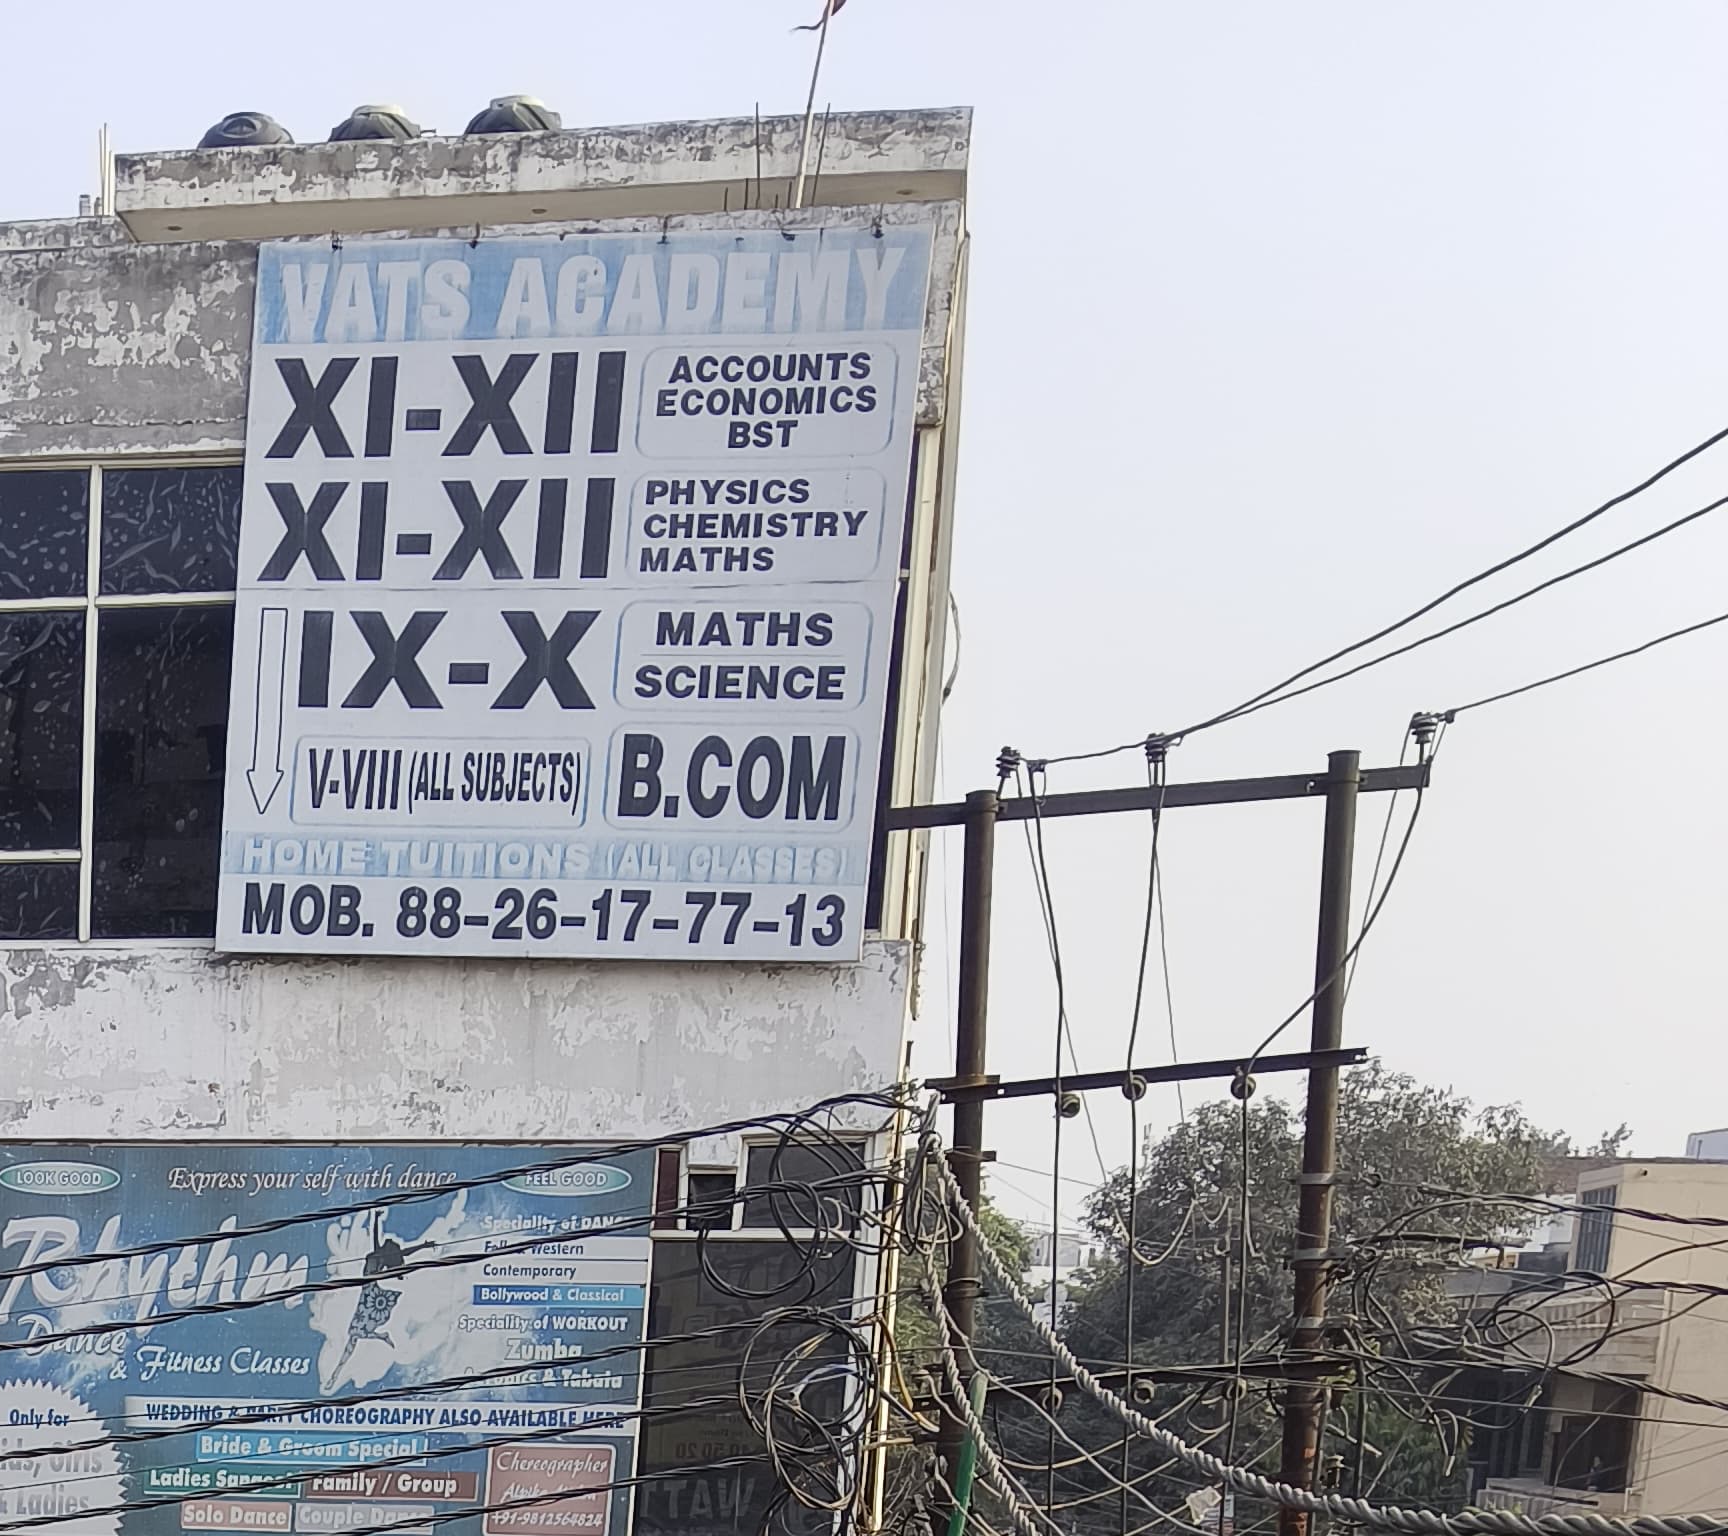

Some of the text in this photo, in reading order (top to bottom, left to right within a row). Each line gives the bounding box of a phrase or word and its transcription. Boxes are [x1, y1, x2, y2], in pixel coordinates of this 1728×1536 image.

[281, 245, 908, 341] VATS ACADEMY
[669, 353, 872, 384] ACCOUNTS
[264, 351, 627, 459] XI-XII
[655, 385, 878, 418] ECONOMICS
[727, 420, 798, 450] BST
[644, 479, 811, 506] PHYSICS
[256, 477, 617, 582] XI-XII
[642, 511, 869, 540] CHEMISTRY
[639, 547, 775, 573] MATHS
[655, 612, 834, 647] MATHS
[297, 610, 603, 710] IX-X
[633, 666, 846, 701] SCIENCE
[307, 748, 582, 811] V-VIII (ALL SUBJECTS)
[617, 734, 846, 821] B.COM
[241, 839, 849, 882] HOME TUITIONS (ALL CLASSES)
[241, 881, 846, 948] MOB. 88-26-17-77-13
[16, 1170, 103, 1186] LOOK GOOD
[169, 1164, 457, 1198] Express your self with dance
[525, 1170, 608, 1187] FEEL GOOD
[482, 1262, 577, 1280] Contemporary
[480, 1287, 625, 1304] Bollywood & Classical
[458, 1314, 628, 1333] Speciality of WORKOUT
[108, 1344, 310, 1383] & Fitness Classes
[503, 1337, 584, 1361] Zumba
[9, 1408, 71, 1429] Only for
[145, 1403, 223, 1422] WEDDING
[300, 1405, 437, 1426] CHOREOGRAPHY
[439, 1408, 481, 1426] ALSO
[486, 1408, 576, 1428] AVAILABLE
[200, 1435, 418, 1460] Bride & Groom Special
[149, 1467, 211, 1488] Ladies
[311, 1473, 458, 1498] Family / Group
[182, 1503, 288, 1525] Solo Dance
[299, 1506, 366, 1529] Couple
